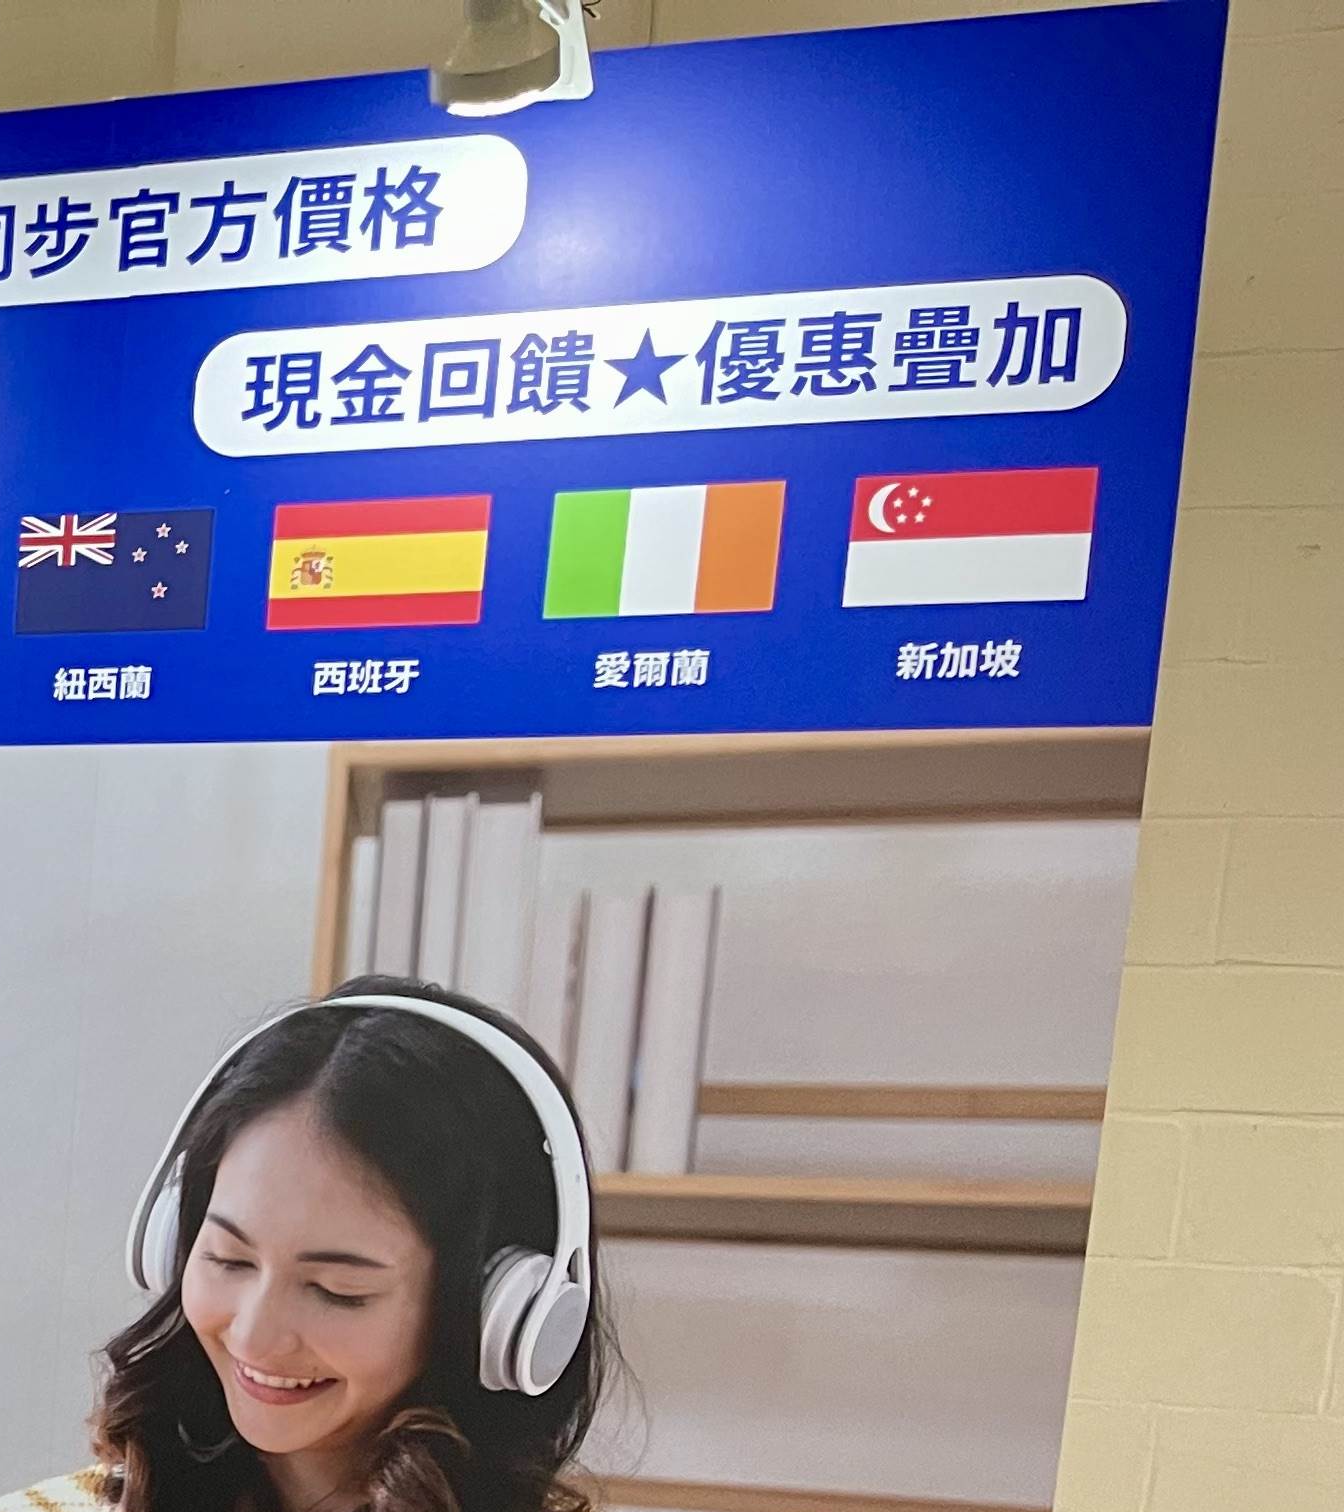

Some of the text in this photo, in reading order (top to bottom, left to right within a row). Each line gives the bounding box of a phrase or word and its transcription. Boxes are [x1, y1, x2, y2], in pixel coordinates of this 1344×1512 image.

[312, 660, 420, 697] 西班牙
[593, 650, 708, 689] 愛爾蘭
[896, 640, 1023, 681] 新加坡
[52, 666, 152, 701] 紐西蘭
